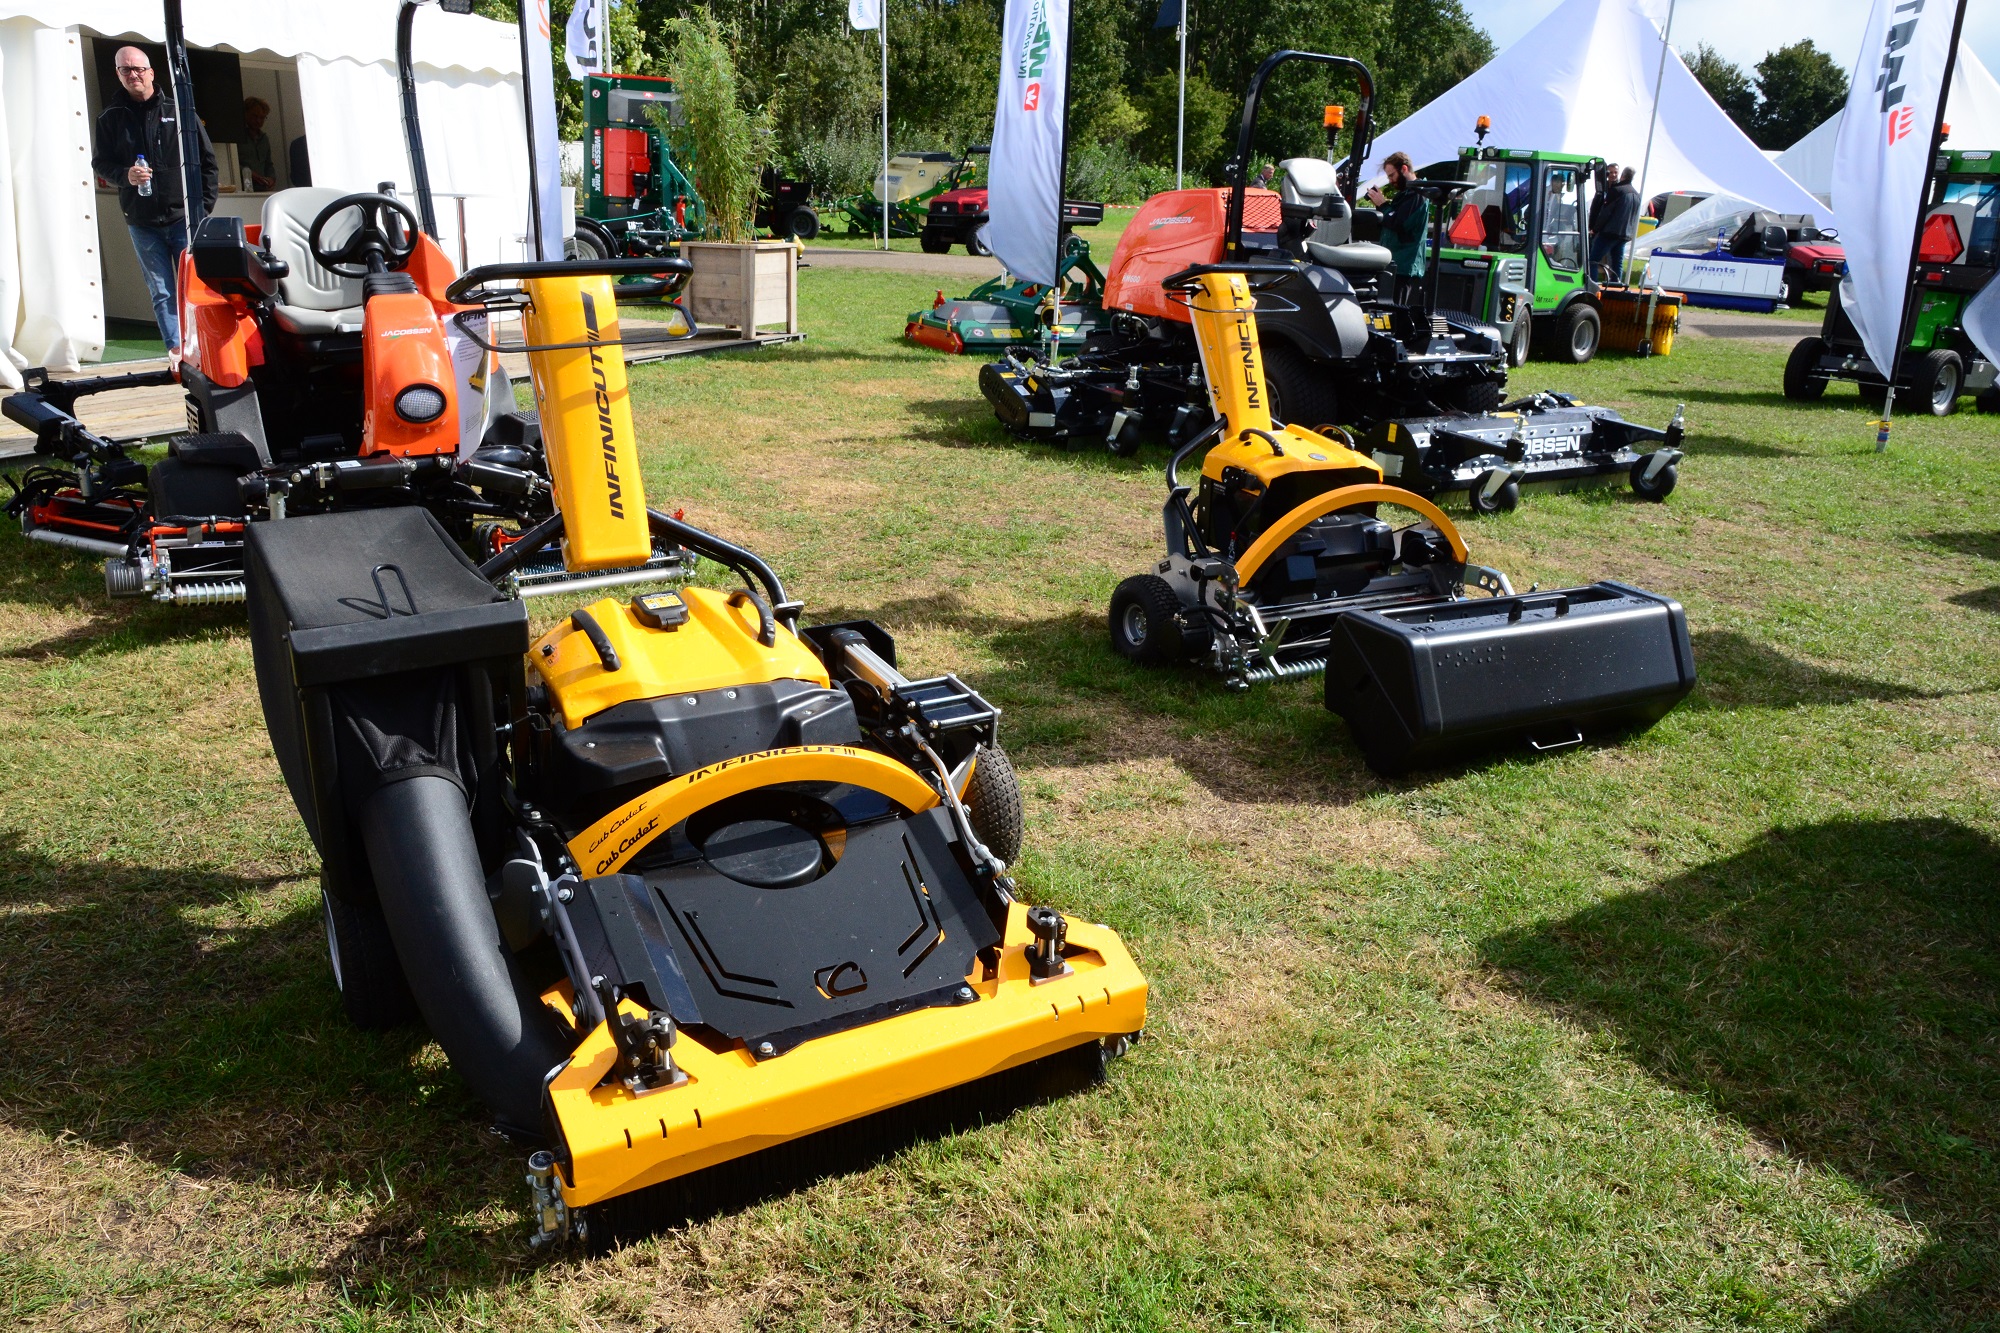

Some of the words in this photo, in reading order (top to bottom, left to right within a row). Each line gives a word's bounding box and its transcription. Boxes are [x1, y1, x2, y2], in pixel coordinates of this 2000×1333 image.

[1149, 217, 1195, 226] JACOBSEN
[1693, 264, 1736, 273] imants
[381, 327, 432, 337] JACOBSEN
[1230, 285, 1260, 408] INFINICUT
[588, 345, 625, 520] INFINICUT
[688, 746, 840, 784] INFINICUT
[589, 832, 609, 853] Cub
[610, 801, 648, 833] Cadet
[596, 850, 619, 875] Cub
[619, 815, 658, 854] Cadet
